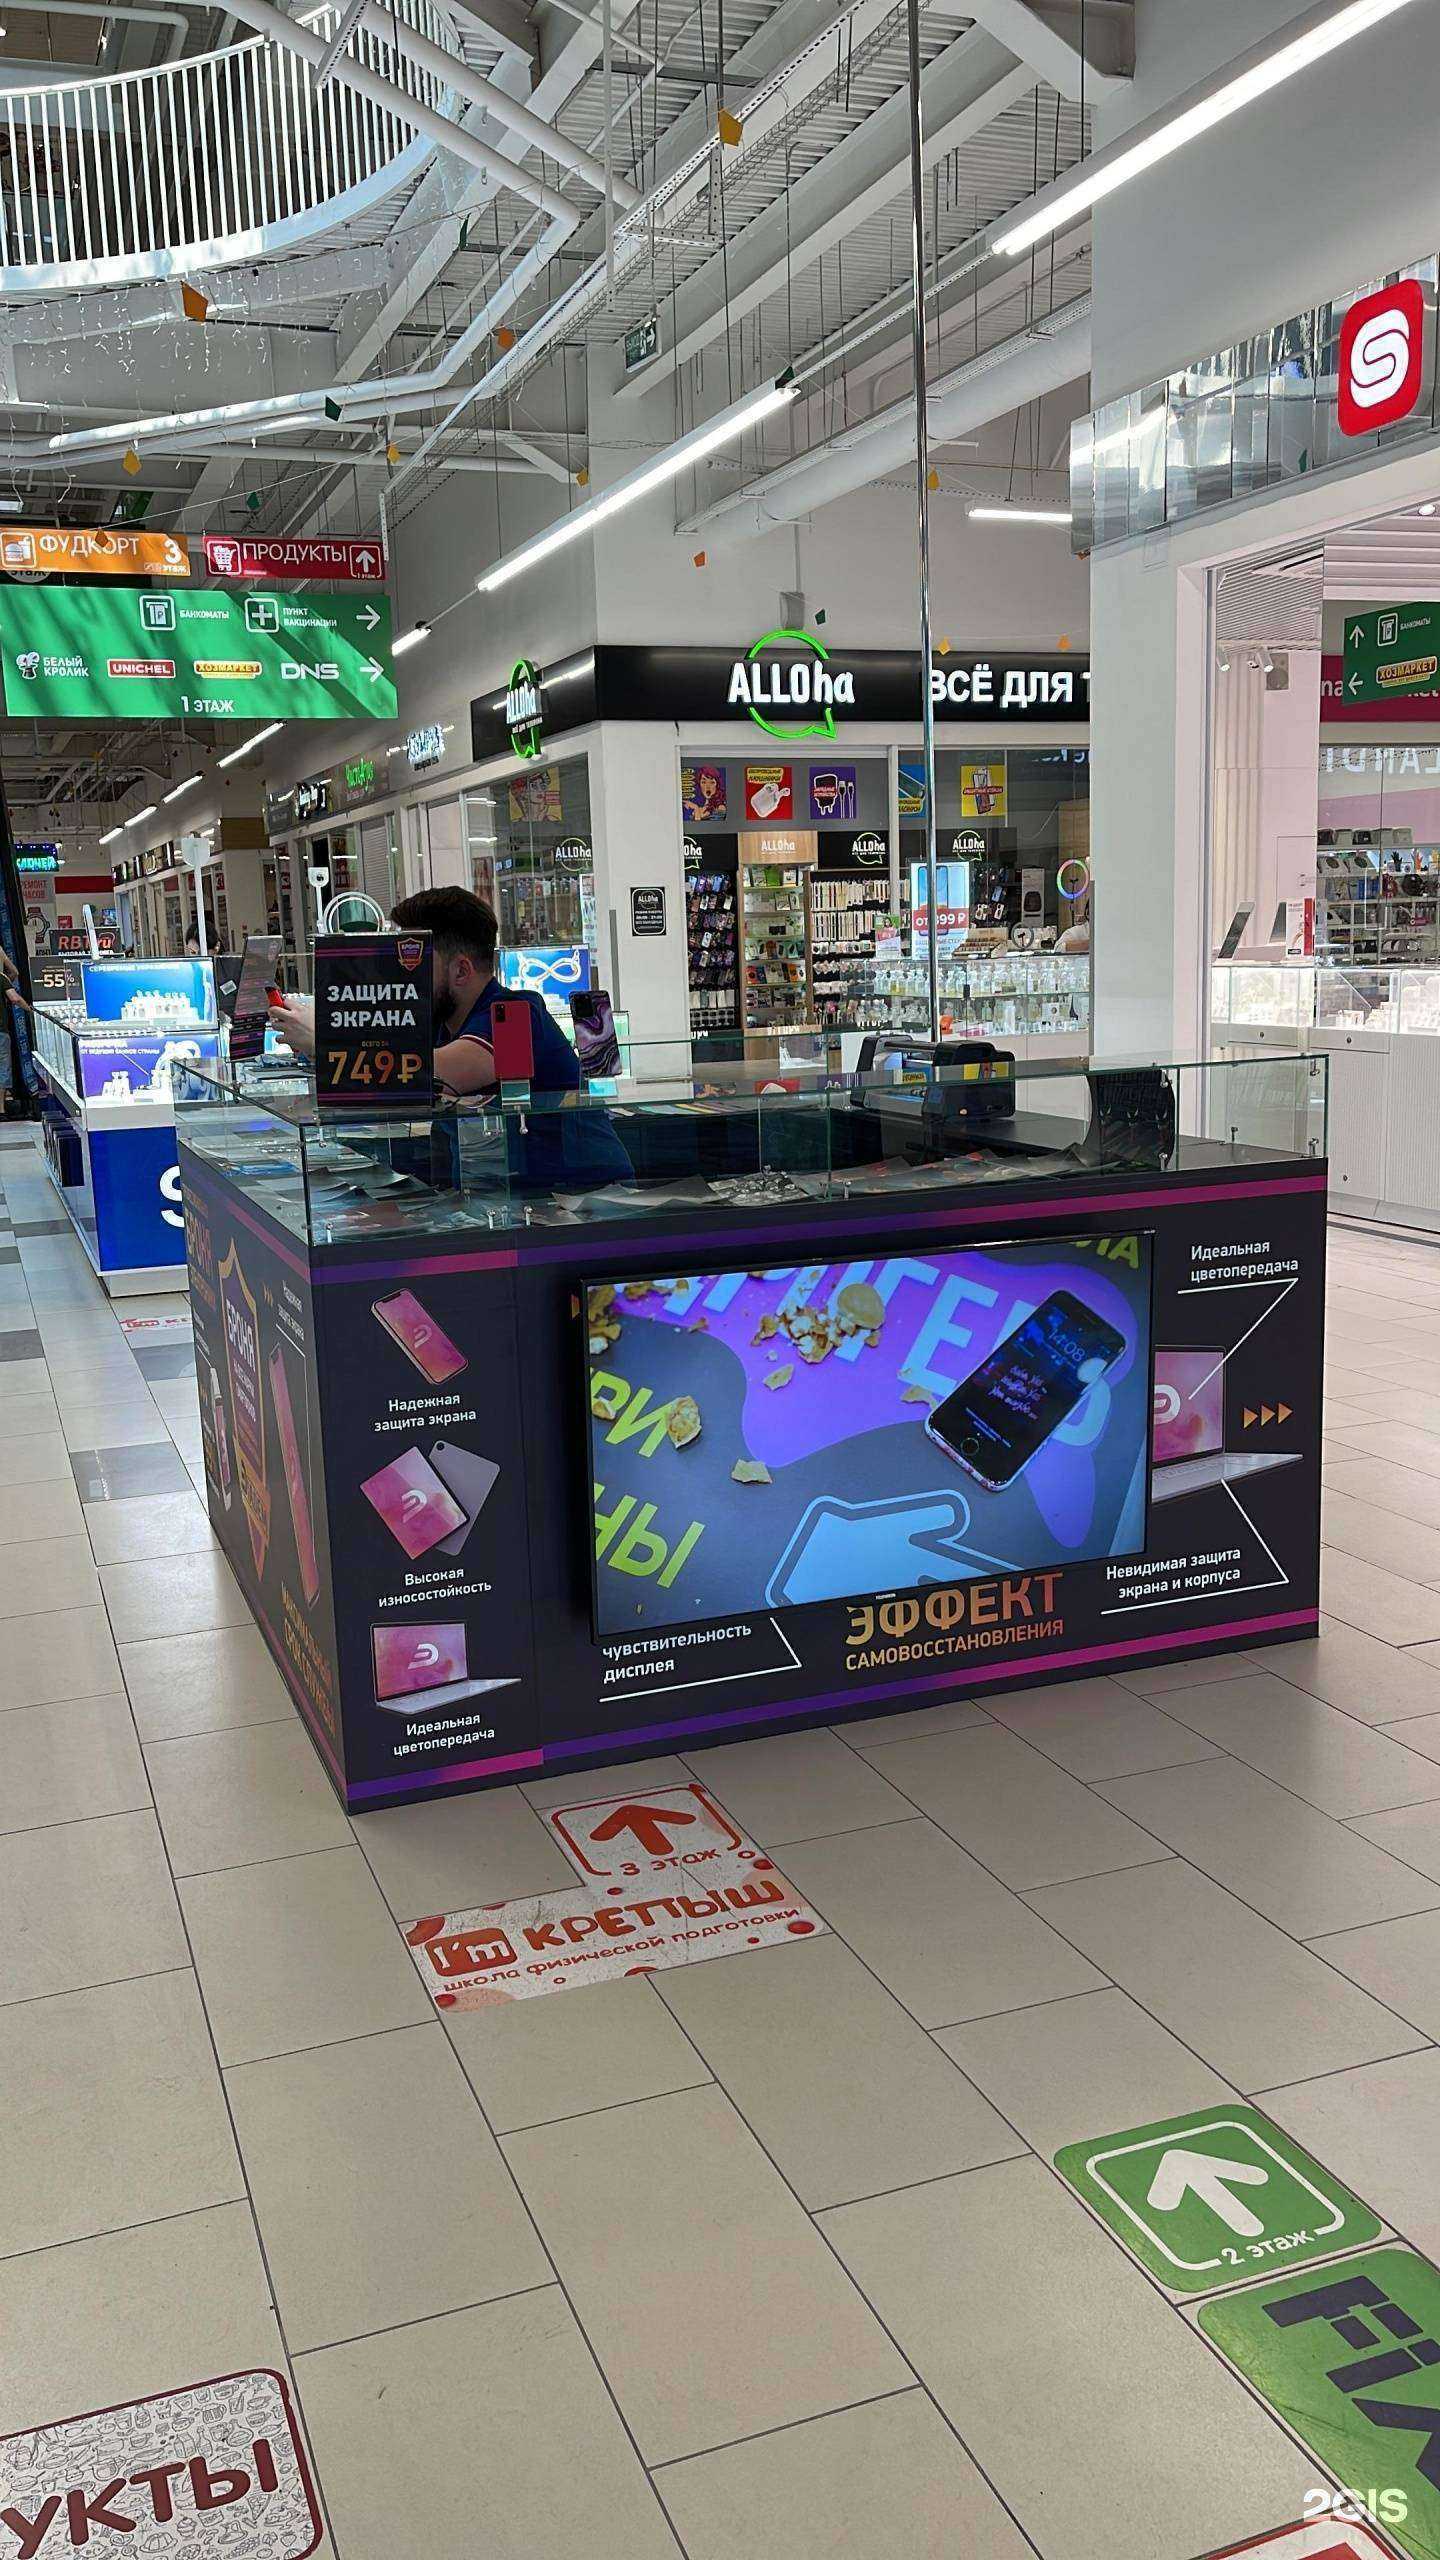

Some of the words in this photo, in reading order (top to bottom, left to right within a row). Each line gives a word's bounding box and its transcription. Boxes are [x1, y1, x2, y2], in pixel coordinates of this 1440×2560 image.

[39, 535, 139, 558] ФУДКОРТ
[164, 539, 182, 564] 3
[243, 543, 347, 565] ПРОДУКТЫ
[180, 609, 229, 620] БАНКОМАТЫ
[283, 607, 308, 616] ПУНКТ
[284, 618, 337, 627] ВАКЦИНАЦИИ
[43, 656, 83, 667] БЕЛЫЙ
[44, 667, 90, 678] КРОЛИК
[112, 663, 171, 675] UNICHEL
[196, 662, 260, 674] ХОЗМАРКЕТ
[281, 663, 340, 680] DNS
[1379, 660, 1435, 680] ХОЗМАРКЕТ
[726, 658, 857, 704] ALLOha
[931, 664, 995, 703] ВСЁ
[1001, 672, 1075, 708] ДЛЯ
[180, 696, 189, 713] 1
[194, 700, 235, 713] ЭТАЖ
[326, 983, 419, 1005] ЗАЩИТА
[330, 1009, 417, 1028] ЭКРАНА
[1190, 1241, 1271, 1261] Идеальная
[1190, 1258, 1299, 1283] цветопередача
[388, 1394, 461, 1412] Надежная
[374, 1416, 425, 1432] защита
[428, 1410, 477, 1427] экрана
[1105, 1557, 1187, 1581] Невидимая
[1190, 1549, 1241, 1567] защита
[404, 1567, 465, 1587] Высокая
[1118, 1581, 1169, 1600] экрана
[1172, 1578, 1181, 1590] и
[1184, 1569, 1241, 1589] корпуса
[378, 1581, 492, 1609] износостойкость
[845, 1572, 1064, 1646] ЭФФЕКТ
[602, 1625, 752, 1661] чувствительность
[846, 1618, 1064, 1672] САМОВОССТАНОВЛЕНИЯ
[603, 1659, 675, 1685] дисплея
[405, 1714, 481, 1737] Идеальная
[393, 1727, 495, 1758] цветопередача
[619, 1862, 641, 1877] 3
[652, 1846, 722, 1872] этаж
[522, 1880, 786, 1952] КРЕПЫШ
[443, 1967, 521, 1993] школа
[526, 1936, 665, 1977] физической
[671, 1908, 801, 1943] подготовки
[1221, 2246, 1245, 2267] 2
[1246, 2227, 1318, 2260] этаж
[0, 2438, 279, 2560] УКТЫ
